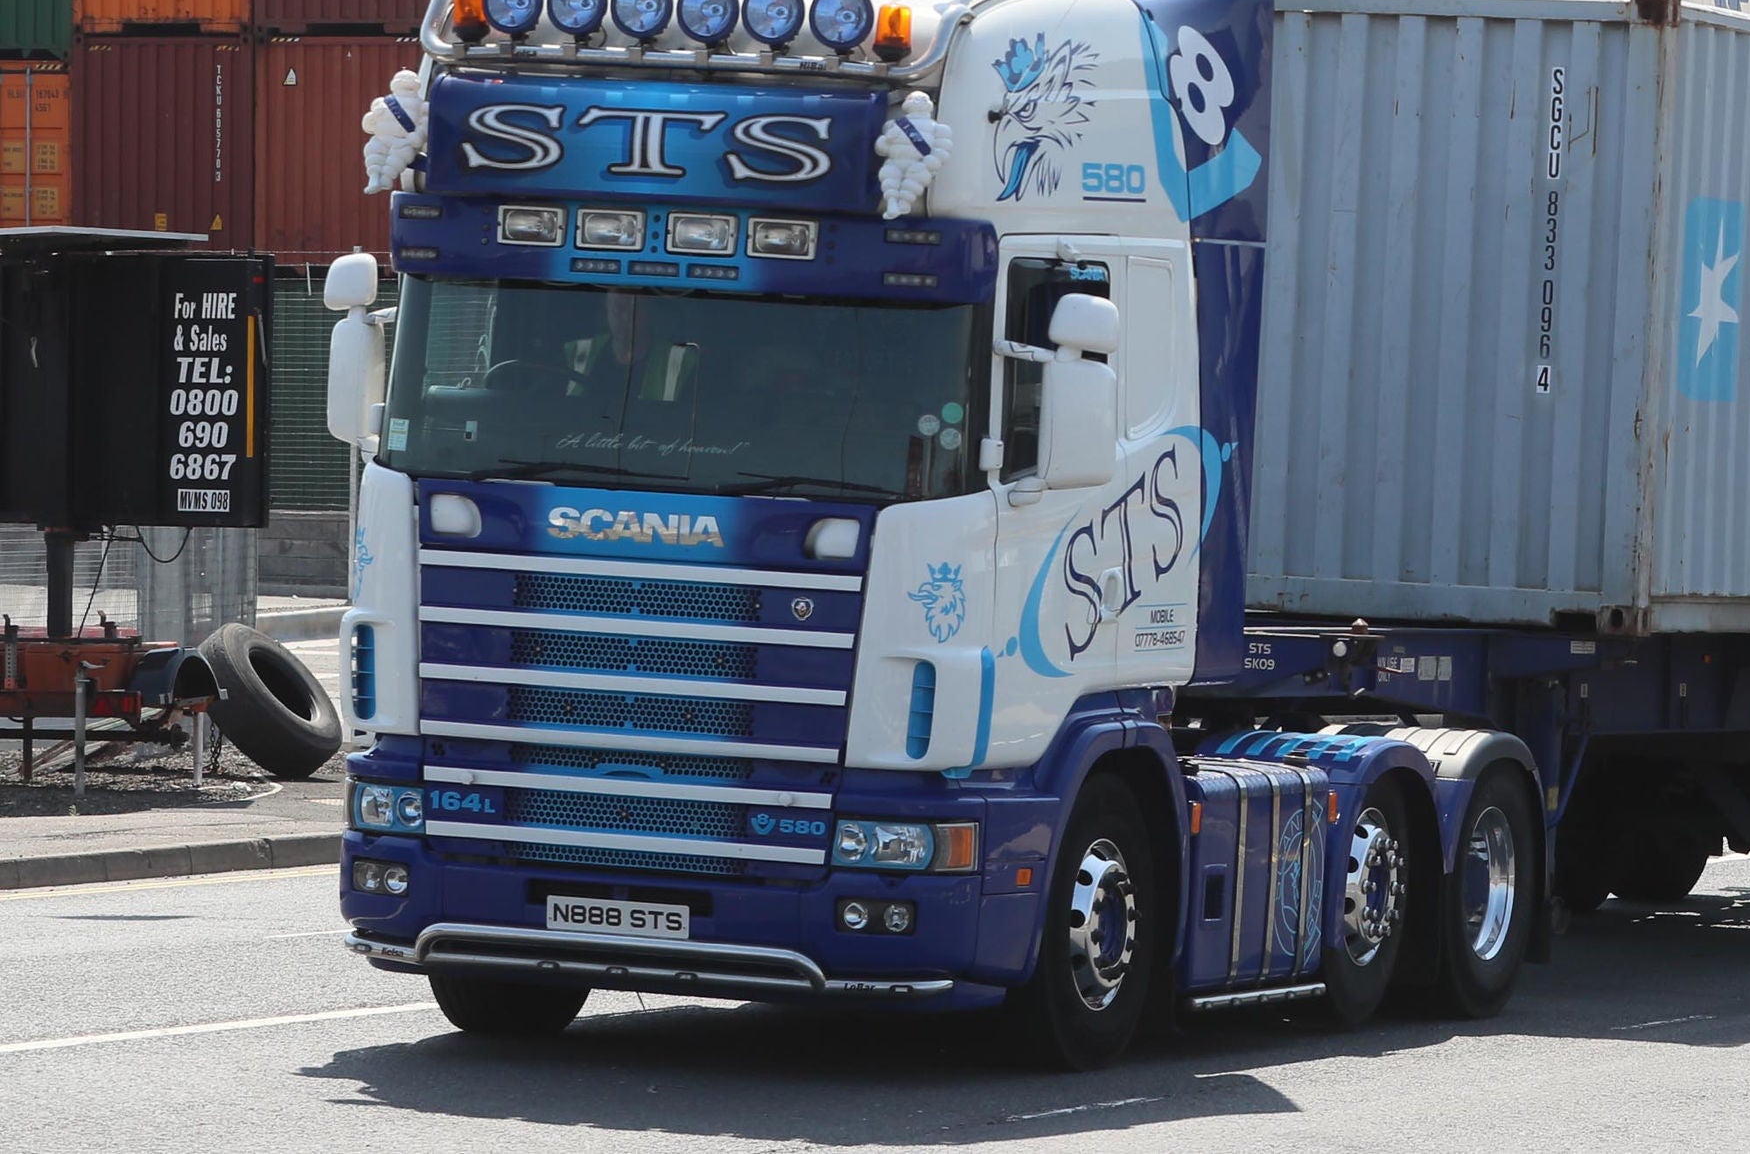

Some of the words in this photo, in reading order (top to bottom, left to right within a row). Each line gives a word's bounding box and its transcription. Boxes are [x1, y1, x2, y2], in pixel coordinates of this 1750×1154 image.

[1547, 68, 1565, 179] SGCU
[462, 102, 831, 182] STS
[1081, 162, 1146, 195] 580
[173, 293, 197, 320] For
[200, 292, 237, 320] HIRE
[173, 327, 185, 351] &
[189, 324, 229, 352] Sales
[176, 357, 233, 384] TEL:
[1536, 365, 1552, 393] 4
[169, 389, 239, 416] 0800
[178, 421, 229, 448] 690
[168, 454, 237, 481] 6867
[211, 491, 230, 512] 098
[547, 505, 726, 548] SCANIA
[1061, 443, 1185, 662] STS
[1150, 607, 1175, 624] MOBILE
[1249, 642, 1272, 655] STS
[1243, 657, 1276, 671] SK09
[779, 819, 827, 836] 580
[552, 902, 622, 927] N888
[629, 908, 683, 932] STS
